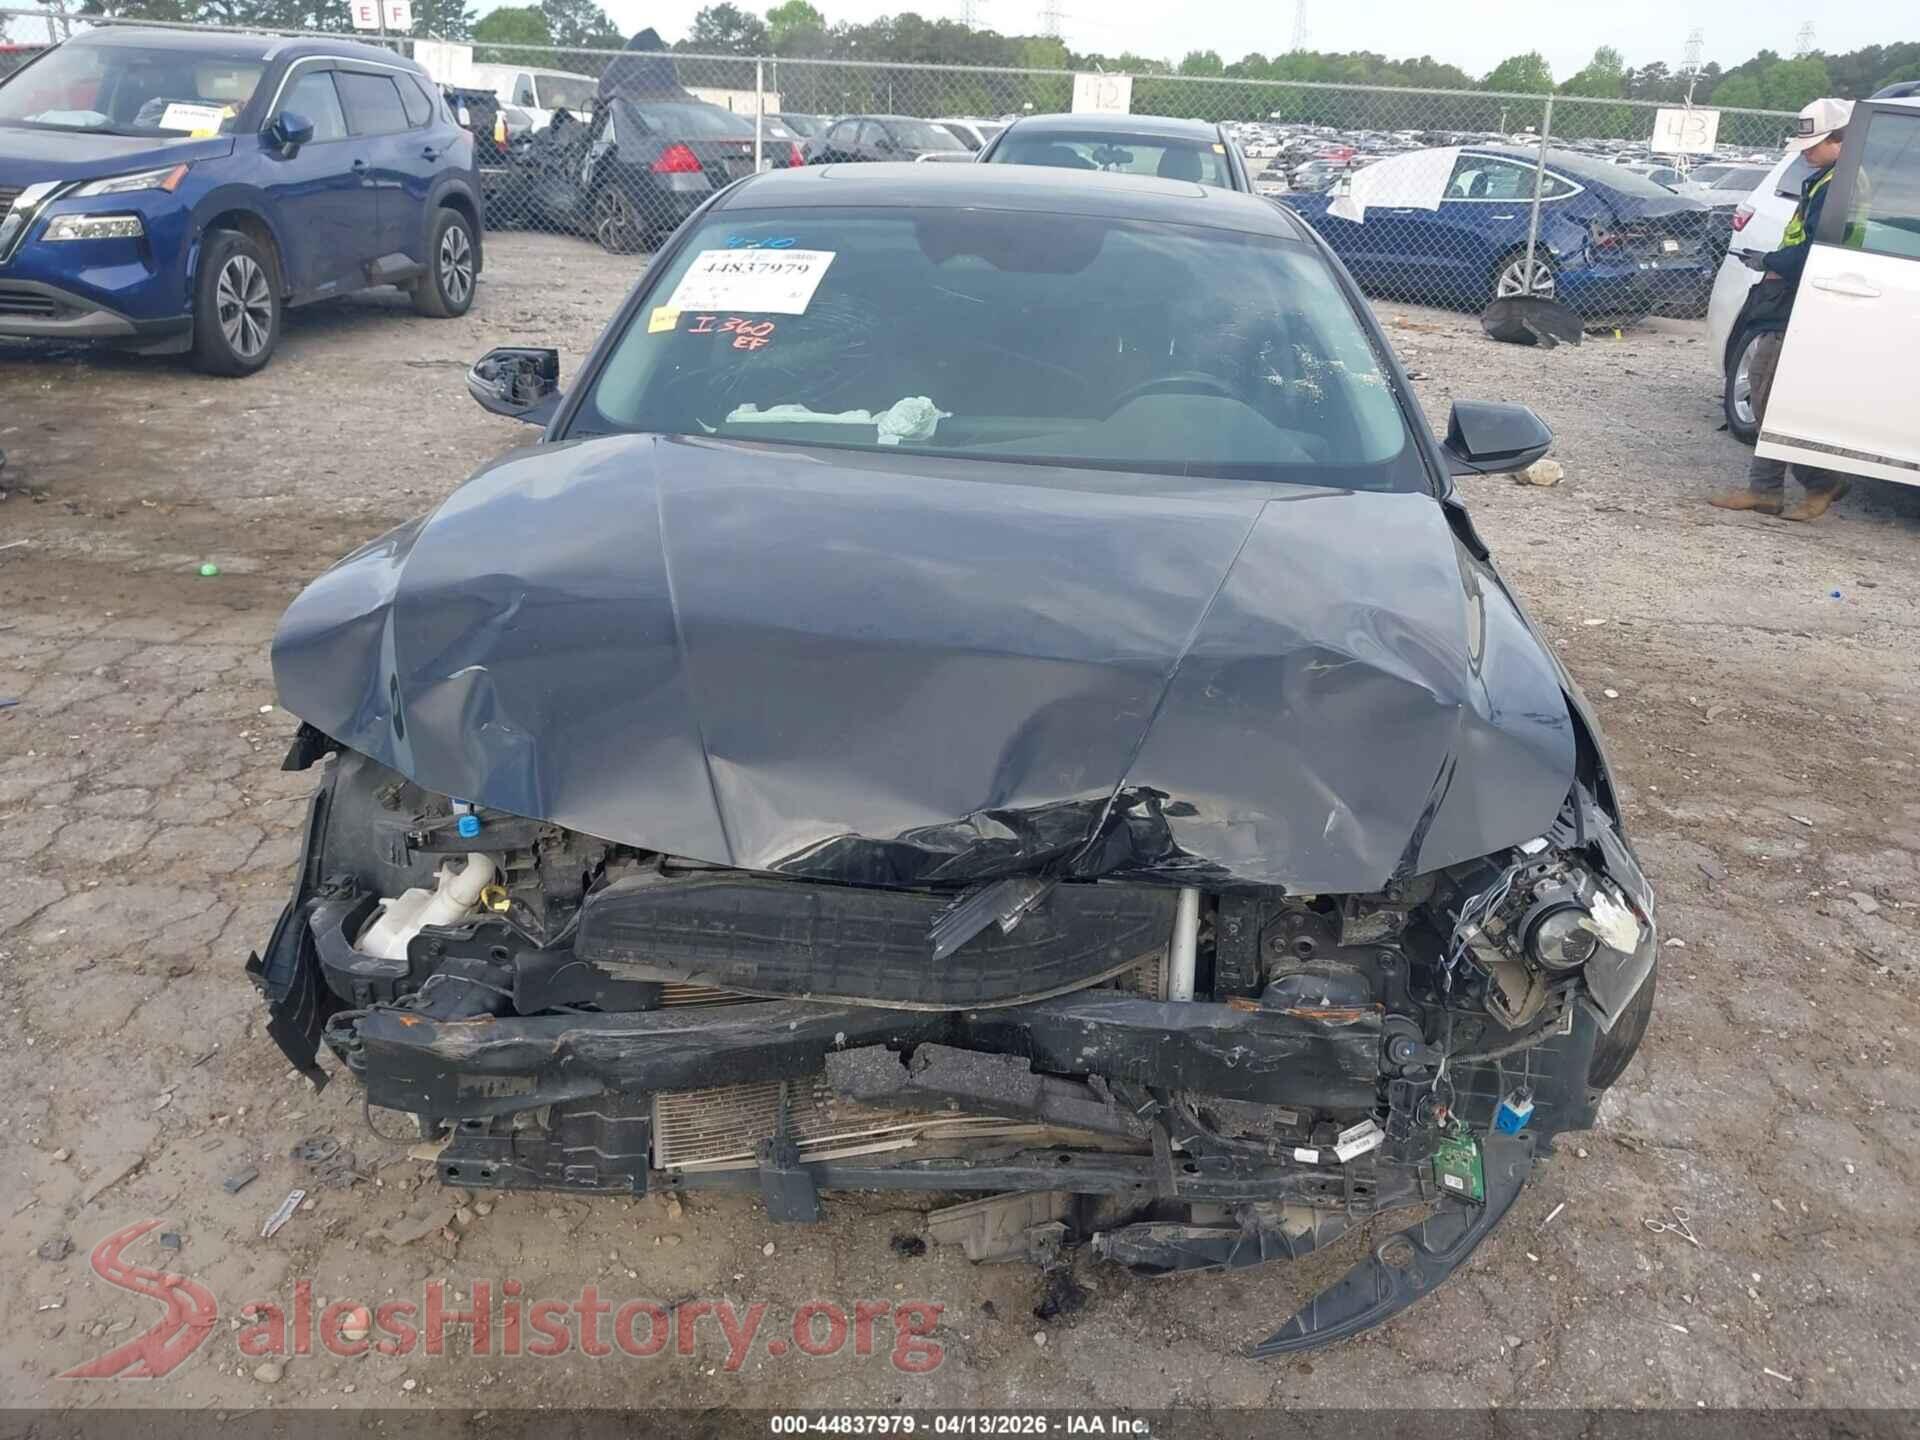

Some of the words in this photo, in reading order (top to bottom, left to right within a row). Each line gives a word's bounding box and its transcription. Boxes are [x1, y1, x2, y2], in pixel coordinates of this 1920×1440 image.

[359, 6, 372, 22] E
[392, 7, 403, 23] F
[1666, 112, 1709, 146] 43
[703, 262, 810, 274] 44837979
[717, 316, 776, 337] 360
[732, 335, 770, 351] EF
